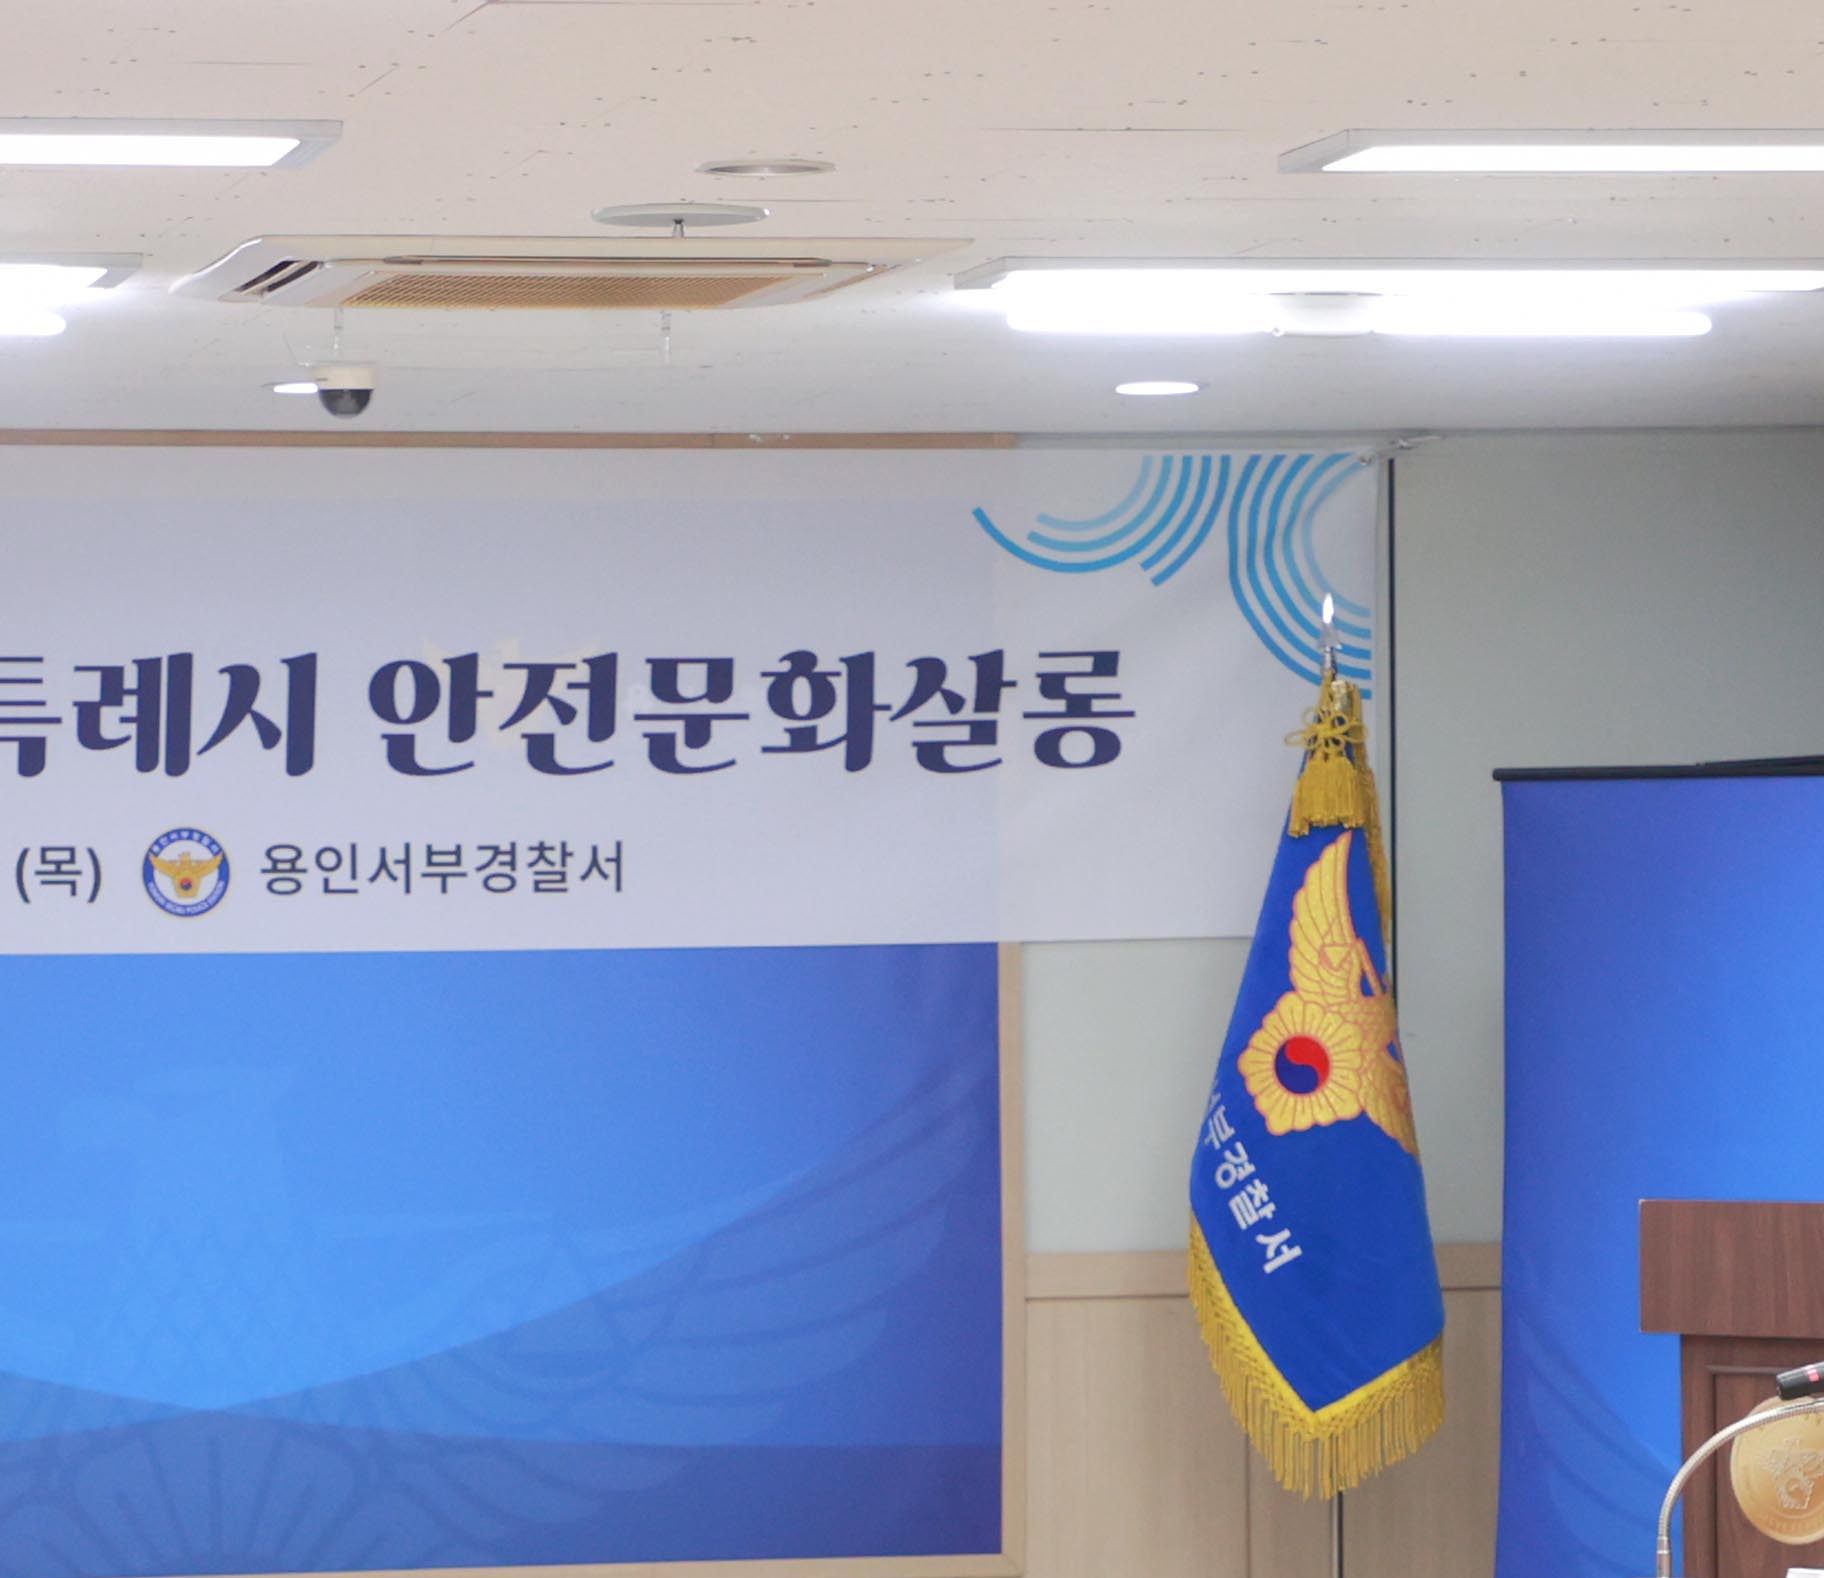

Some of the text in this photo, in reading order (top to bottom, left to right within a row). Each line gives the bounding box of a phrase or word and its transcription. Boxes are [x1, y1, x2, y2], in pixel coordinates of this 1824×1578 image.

[369, 649, 1135, 776] 안전문화살롱
[16, 847, 101, 903] (목)
[261, 841, 621, 895] 용인서부경찰서
